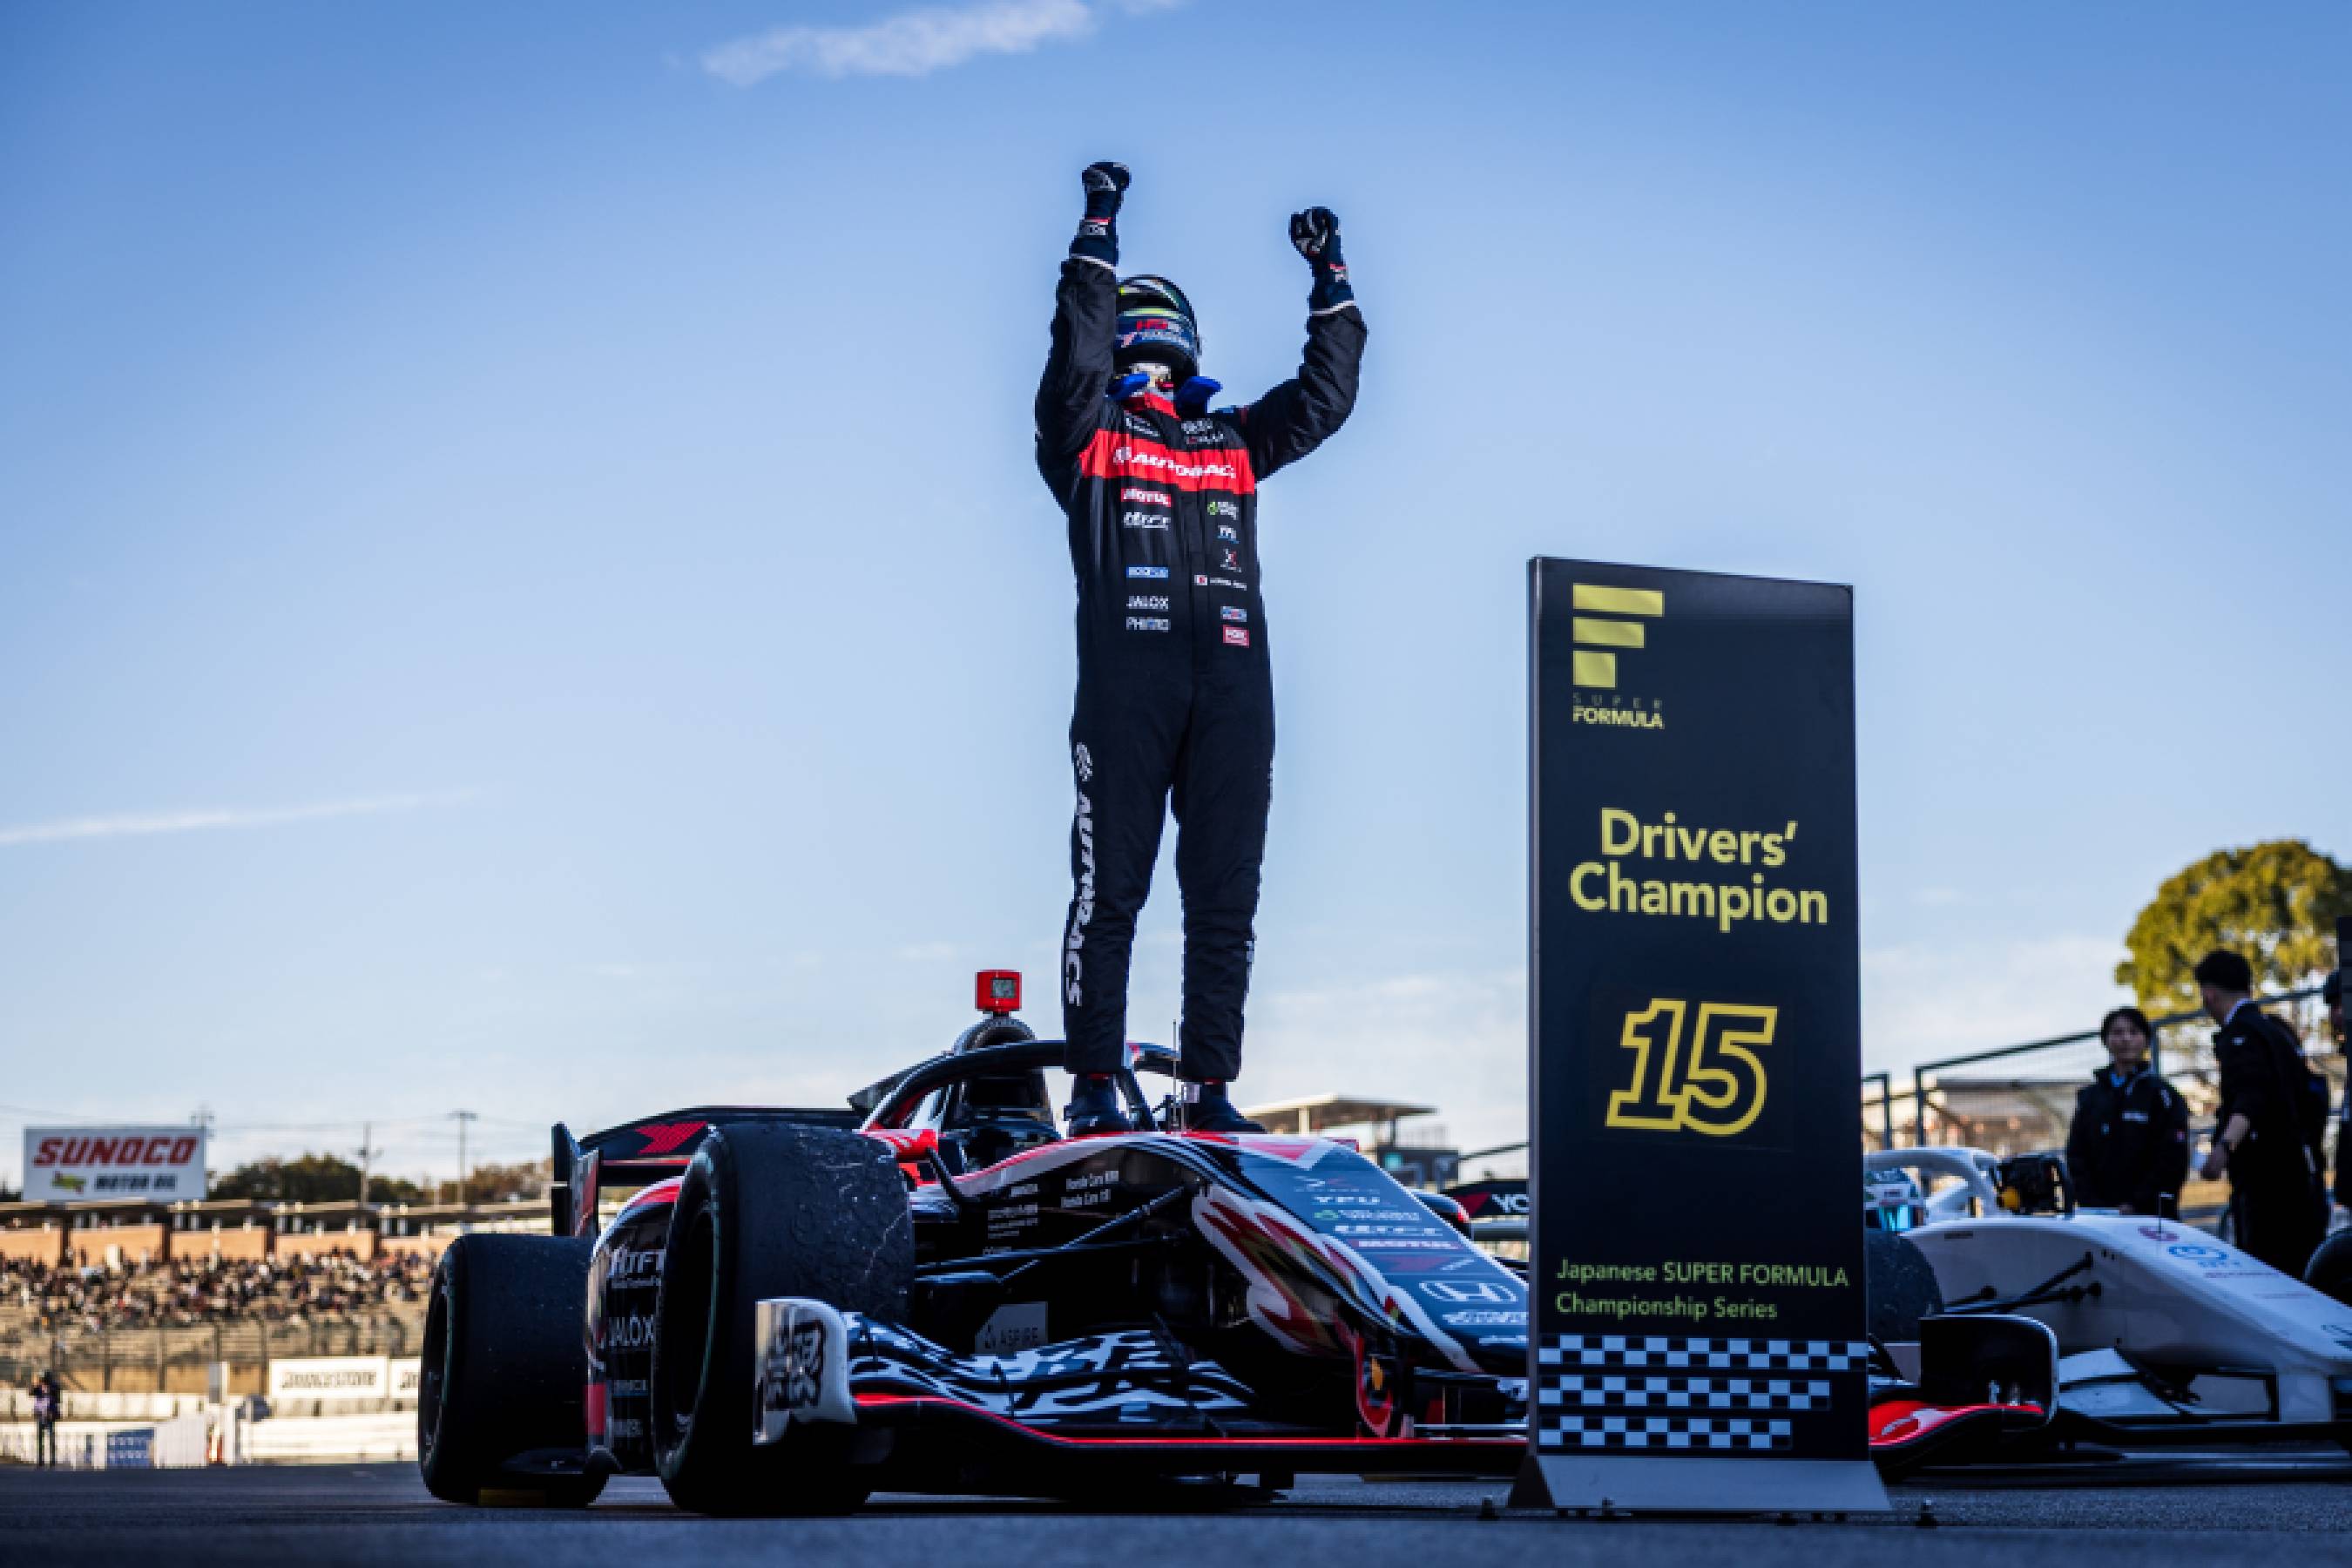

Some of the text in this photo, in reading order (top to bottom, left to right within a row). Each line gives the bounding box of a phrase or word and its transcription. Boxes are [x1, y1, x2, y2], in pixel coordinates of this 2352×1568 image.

[1573, 706, 1665, 729] FORMULA
[1601, 808, 1799, 868] Drivers'
[1569, 861, 1828, 932] Champion
[1605, 997, 1778, 1136] 15
[33, 1136, 199, 1167] SUNOCO
[1556, 1257, 1850, 1287] Japanese SUPER FORMULA
[1556, 1292, 1708, 1321] Championship
[1713, 1295, 1778, 1320] Series
